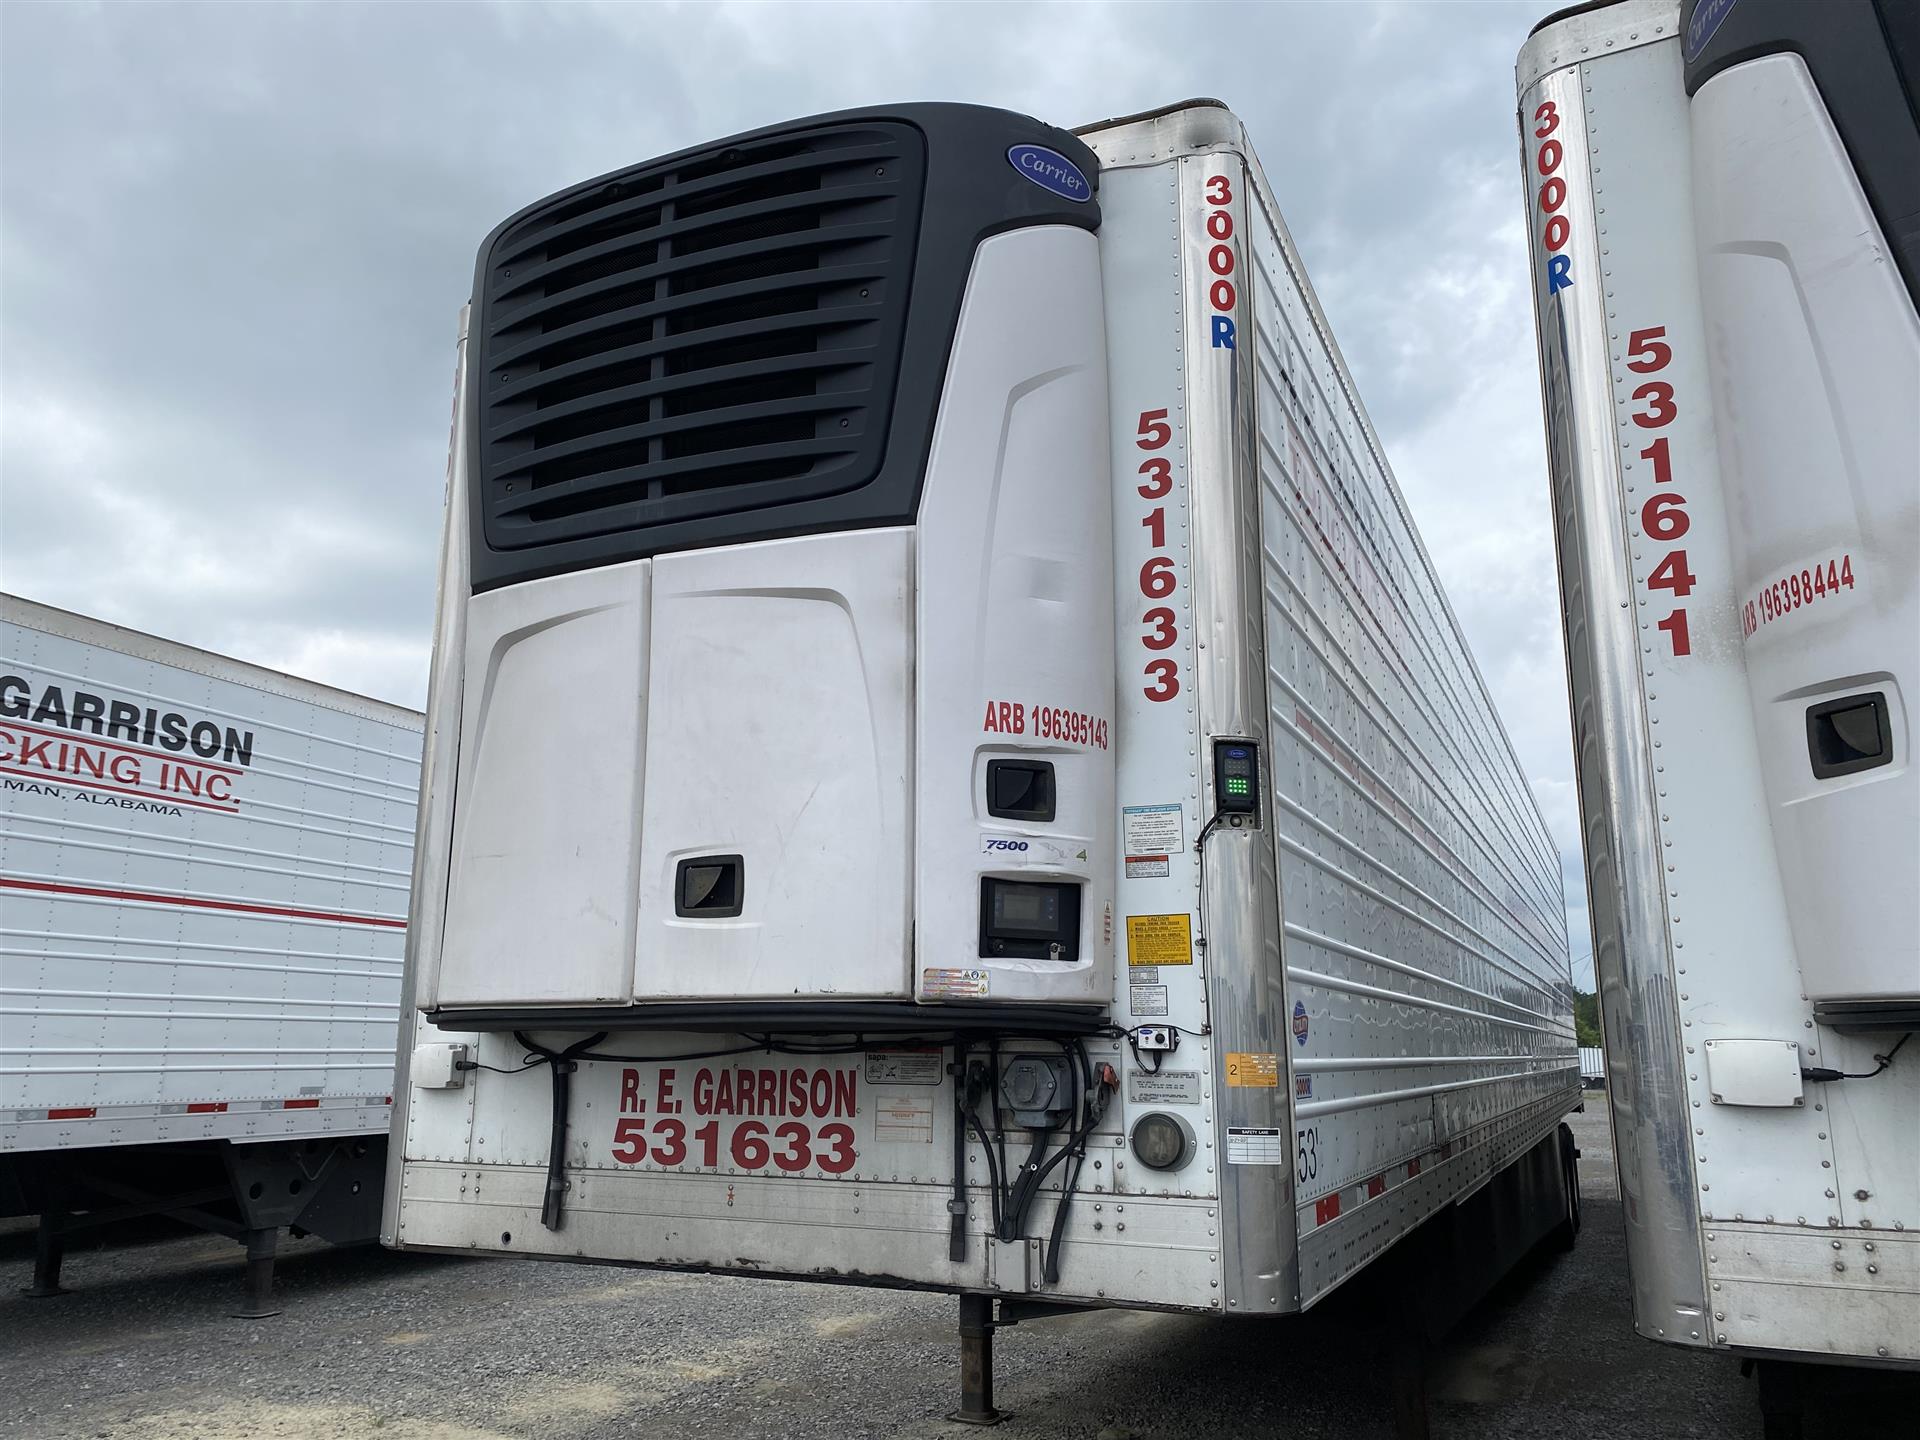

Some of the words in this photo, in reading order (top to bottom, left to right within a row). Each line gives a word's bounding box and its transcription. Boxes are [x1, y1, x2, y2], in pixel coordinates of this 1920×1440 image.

[1020, 152, 1083, 190] Carrier
[1534, 101, 1574, 295] 3000R
[1206, 175, 1236, 350] 3000R
[1626, 326, 1696, 656] 531641
[1136, 408, 1180, 702] 531633
[1759, 555, 1854, 624] 196398444
[0, 675, 253, 766] GARRISON
[984, 701, 1025, 733] ARB
[1032, 705, 1108, 750] 196395143
[0, 779, 66, 800] MAN,
[75, 793, 182, 817] ALABAMA
[160, 763, 240, 804] INC.
[986, 839, 1028, 851] 7500
[621, 1068, 646, 1113] R.
[658, 1069, 682, 1114] E.
[694, 1069, 856, 1118] GARRISON
[1230, 1064, 1237, 1075] 2
[611, 1119, 856, 1173] 531633
